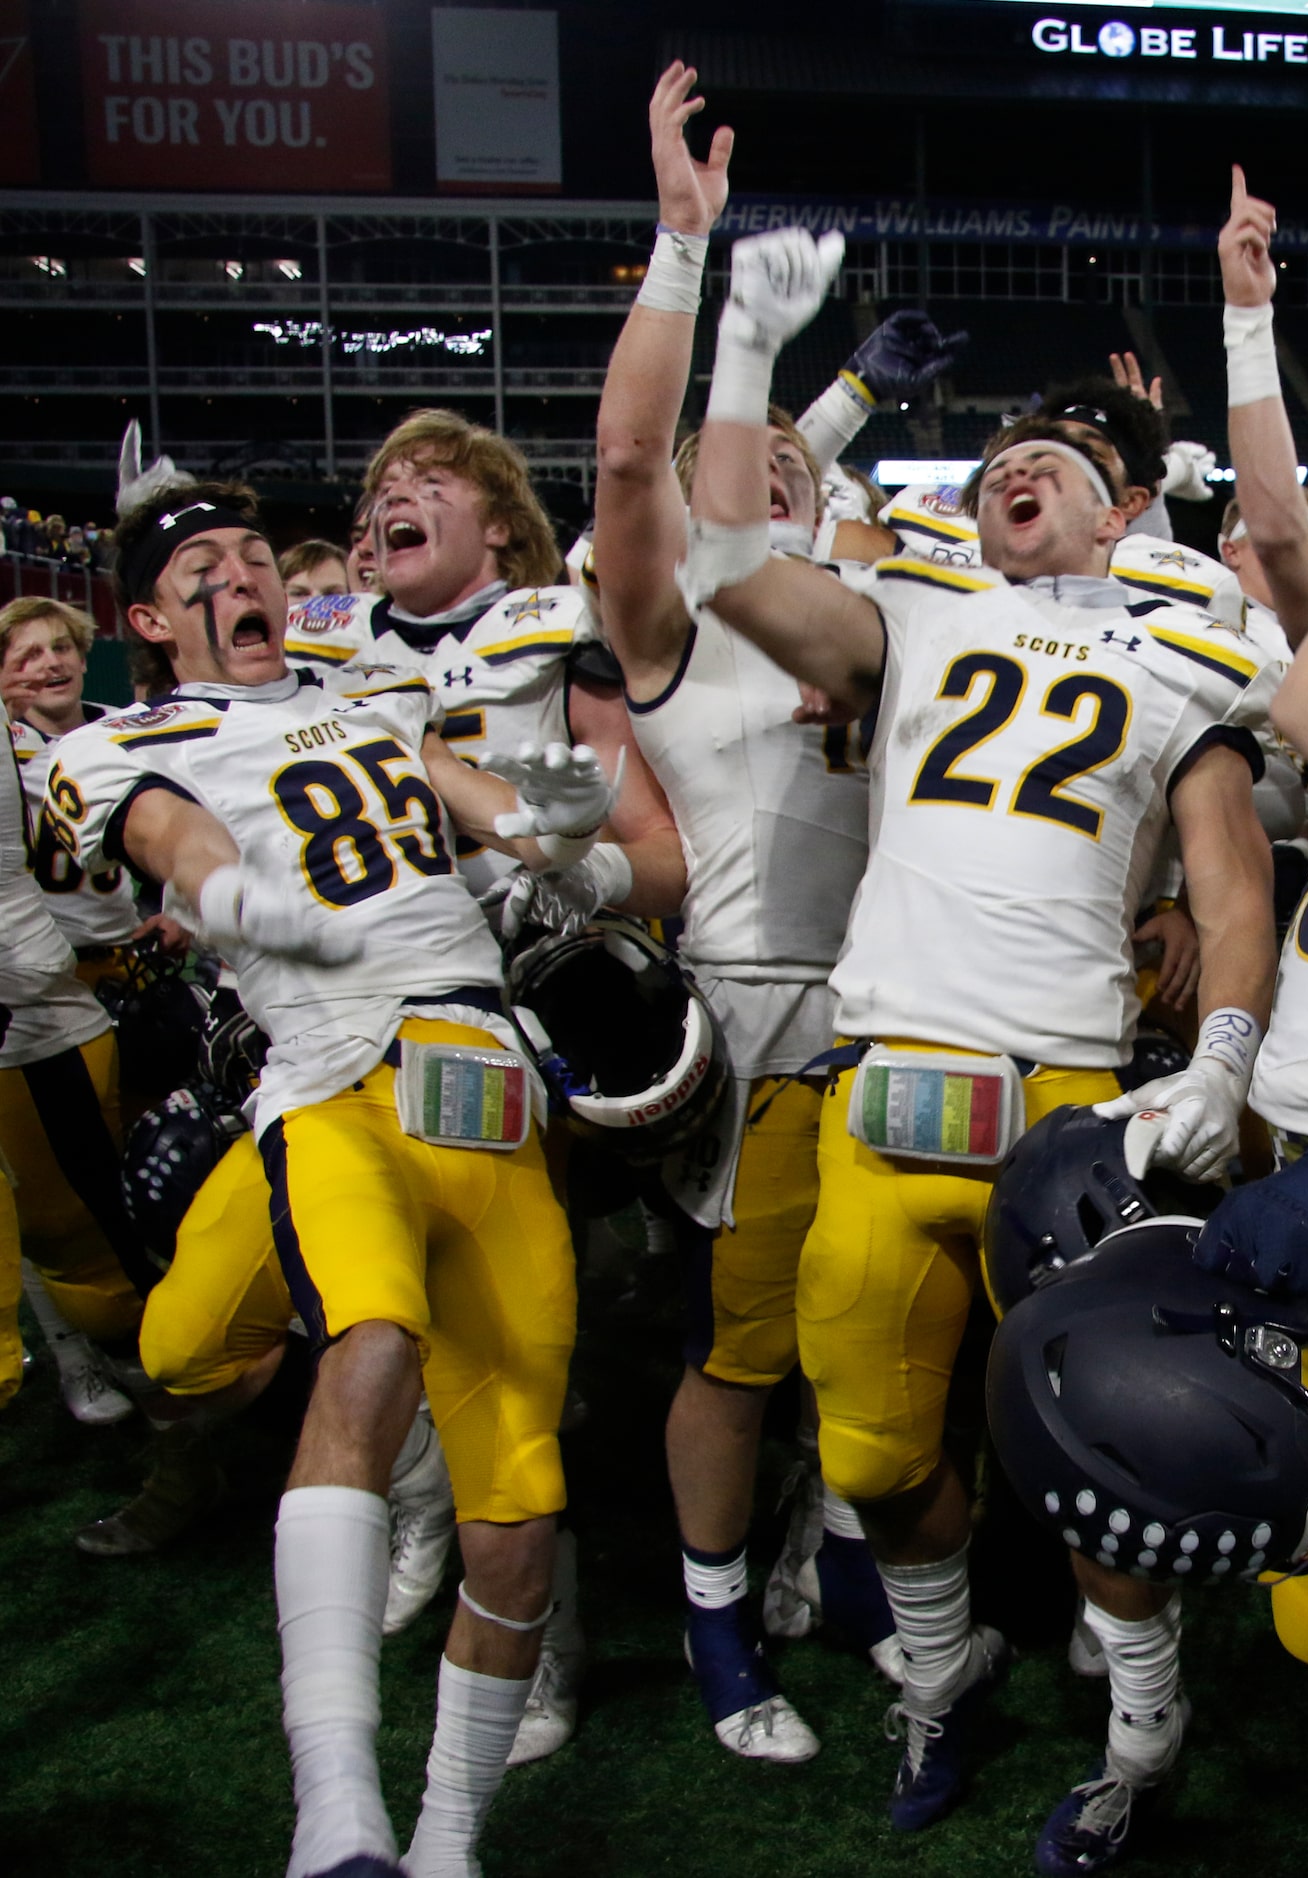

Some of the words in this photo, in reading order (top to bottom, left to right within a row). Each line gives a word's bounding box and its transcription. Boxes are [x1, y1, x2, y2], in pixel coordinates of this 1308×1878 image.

[99, 35, 213, 86] THIS
[228, 38, 374, 91] BUD'S
[1212, 26, 1308, 64] LIFE
[105, 96, 199, 146] FOR
[214, 100, 327, 149] YOU.
[1013, 633, 1090, 663] SCOTS
[284, 719, 348, 754] SCOTS
[907, 650, 1134, 843] 22
[268, 737, 456, 911] 85
